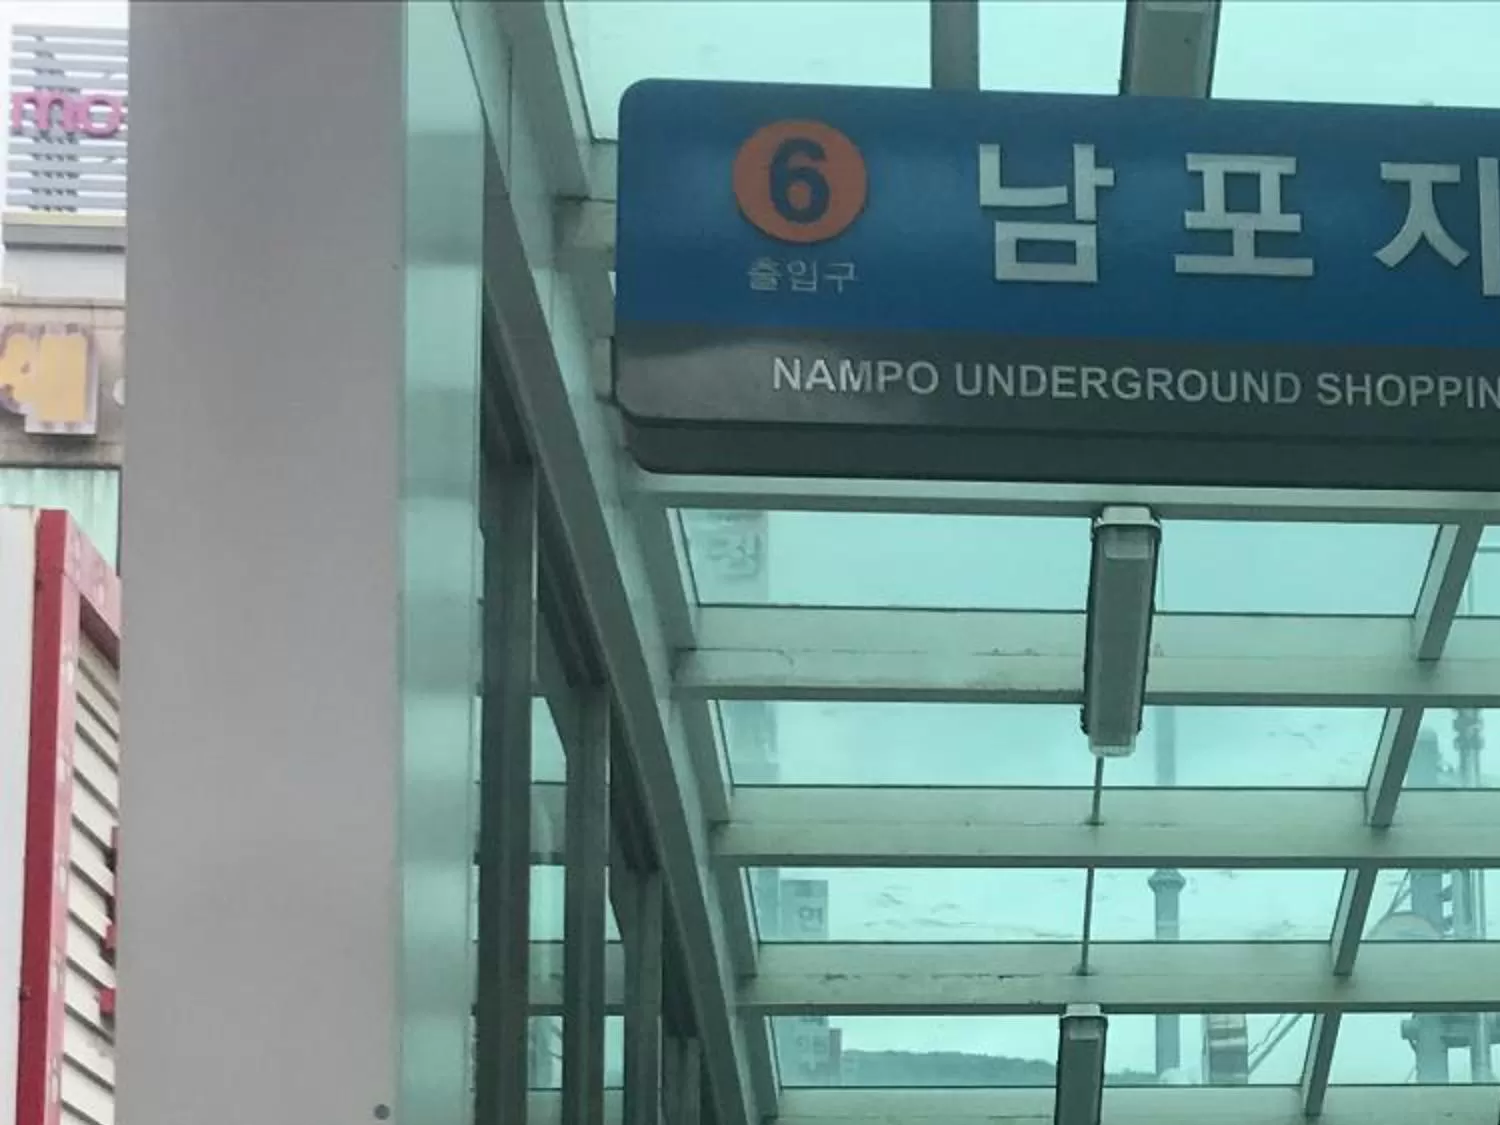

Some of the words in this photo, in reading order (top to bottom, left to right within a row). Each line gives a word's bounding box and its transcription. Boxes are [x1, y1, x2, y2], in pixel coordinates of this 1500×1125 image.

[768, 136, 832, 224] 6
[745, 256, 858, 296] 출입구
[771, 357, 941, 396] NAMPO
[956, 361, 1302, 406] UNDERGROUND
